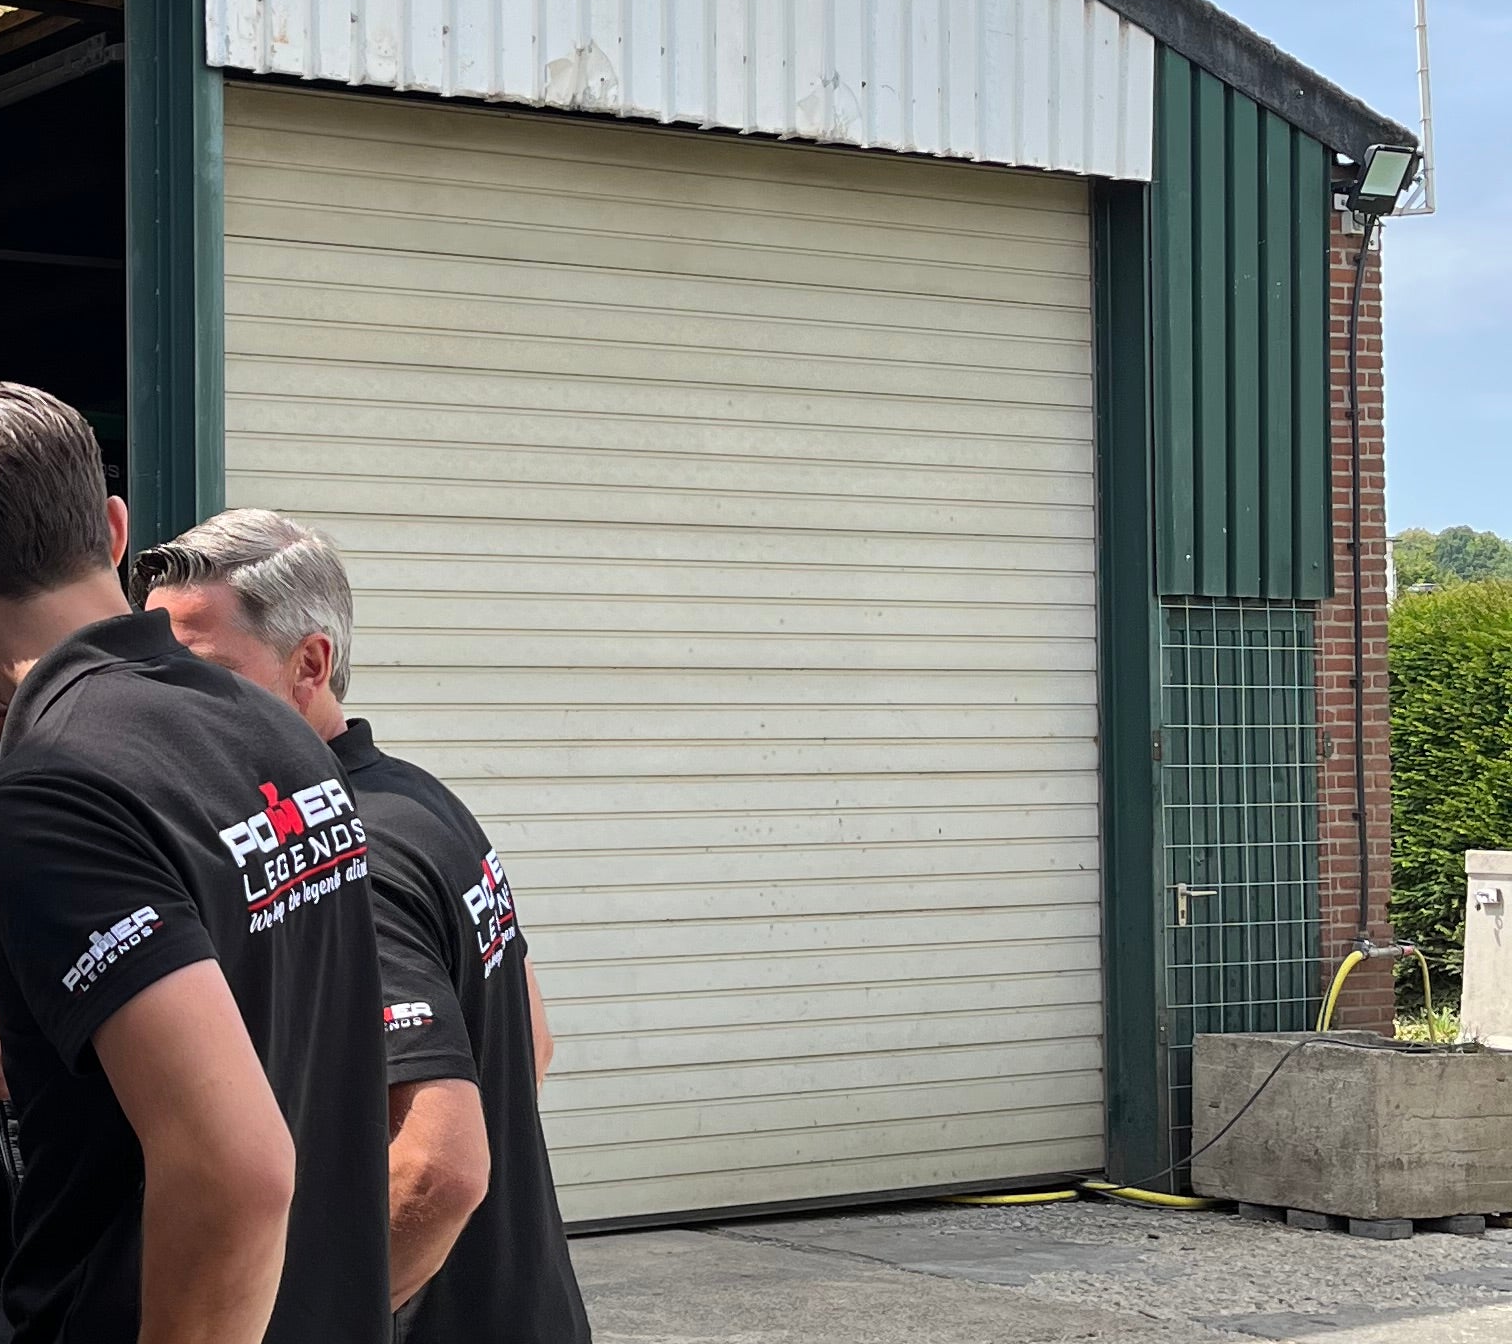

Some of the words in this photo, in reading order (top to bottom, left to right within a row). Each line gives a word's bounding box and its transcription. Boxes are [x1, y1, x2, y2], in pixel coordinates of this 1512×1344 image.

[219, 779, 354, 868] POWER
[243, 818, 366, 902] LEGENDS
[80, 925, 153, 992] LEGENDS
